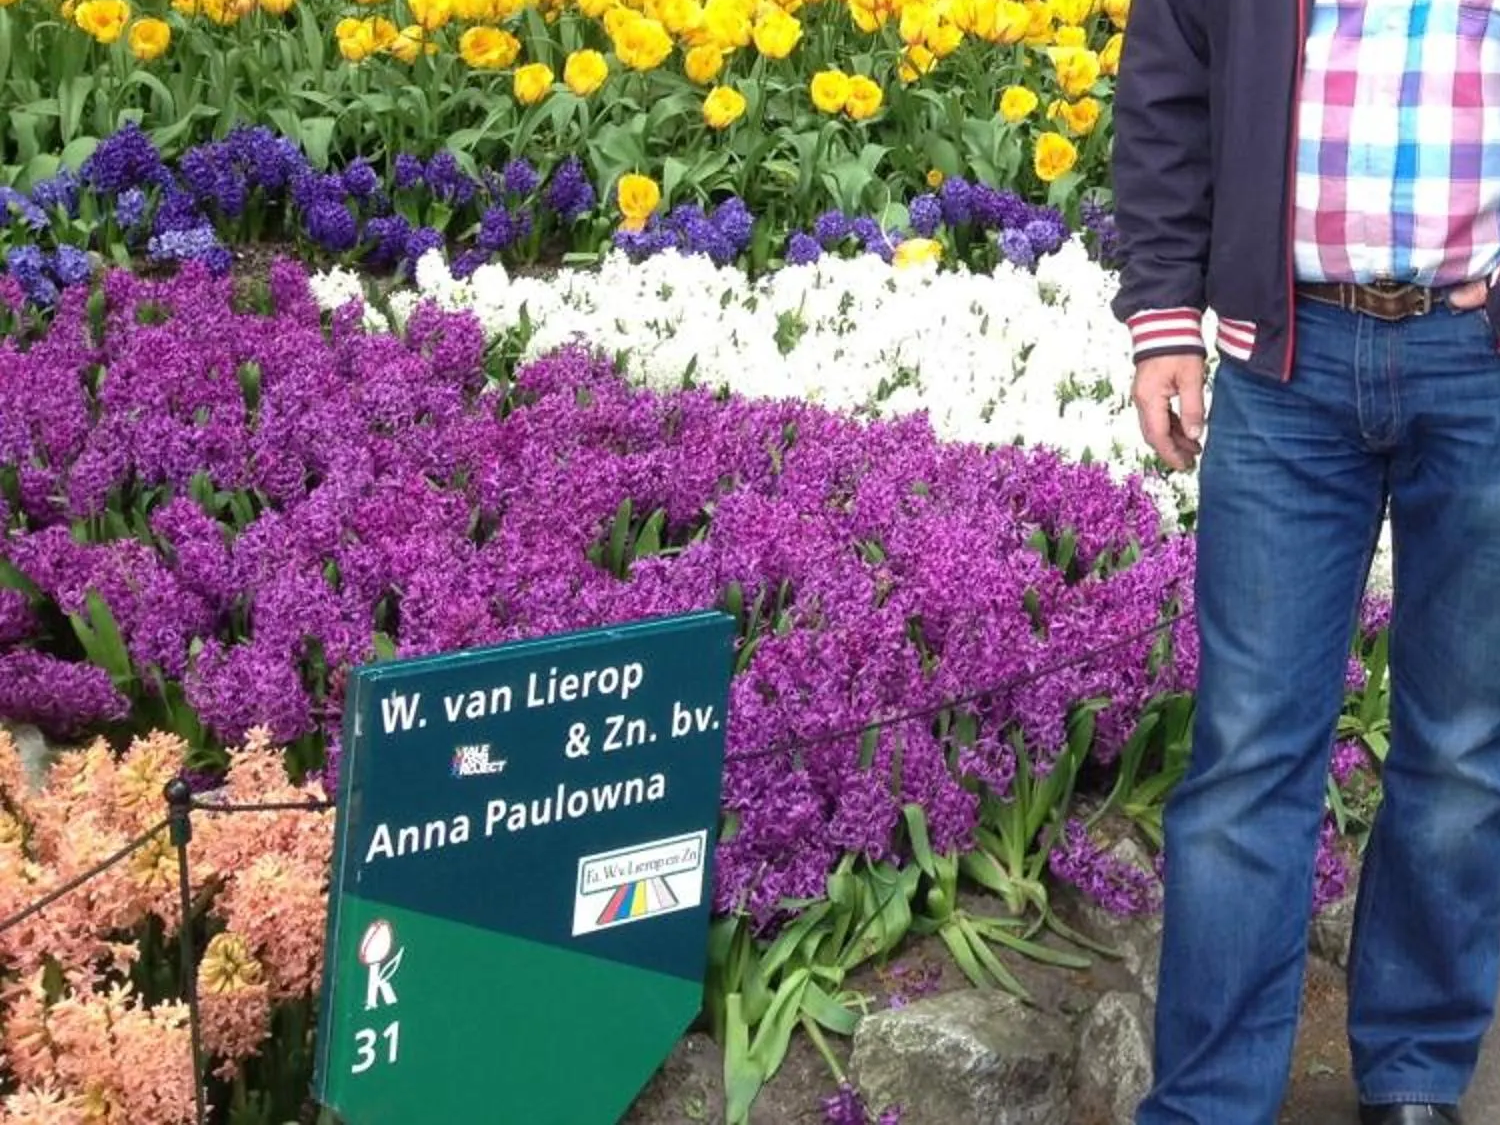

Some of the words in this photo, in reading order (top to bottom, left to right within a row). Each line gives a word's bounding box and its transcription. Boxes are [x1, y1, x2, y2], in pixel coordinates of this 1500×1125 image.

[381, 691, 427, 734] W.
[443, 686, 512, 722] van
[527, 662, 643, 708] Lierop
[565, 722, 591, 758] &
[602, 714, 657, 752] Zn.
[671, 701, 719, 738] bv.
[365, 815, 470, 863] Anna
[485, 773, 665, 836] Paulowna
[351, 1021, 399, 1073] 31
